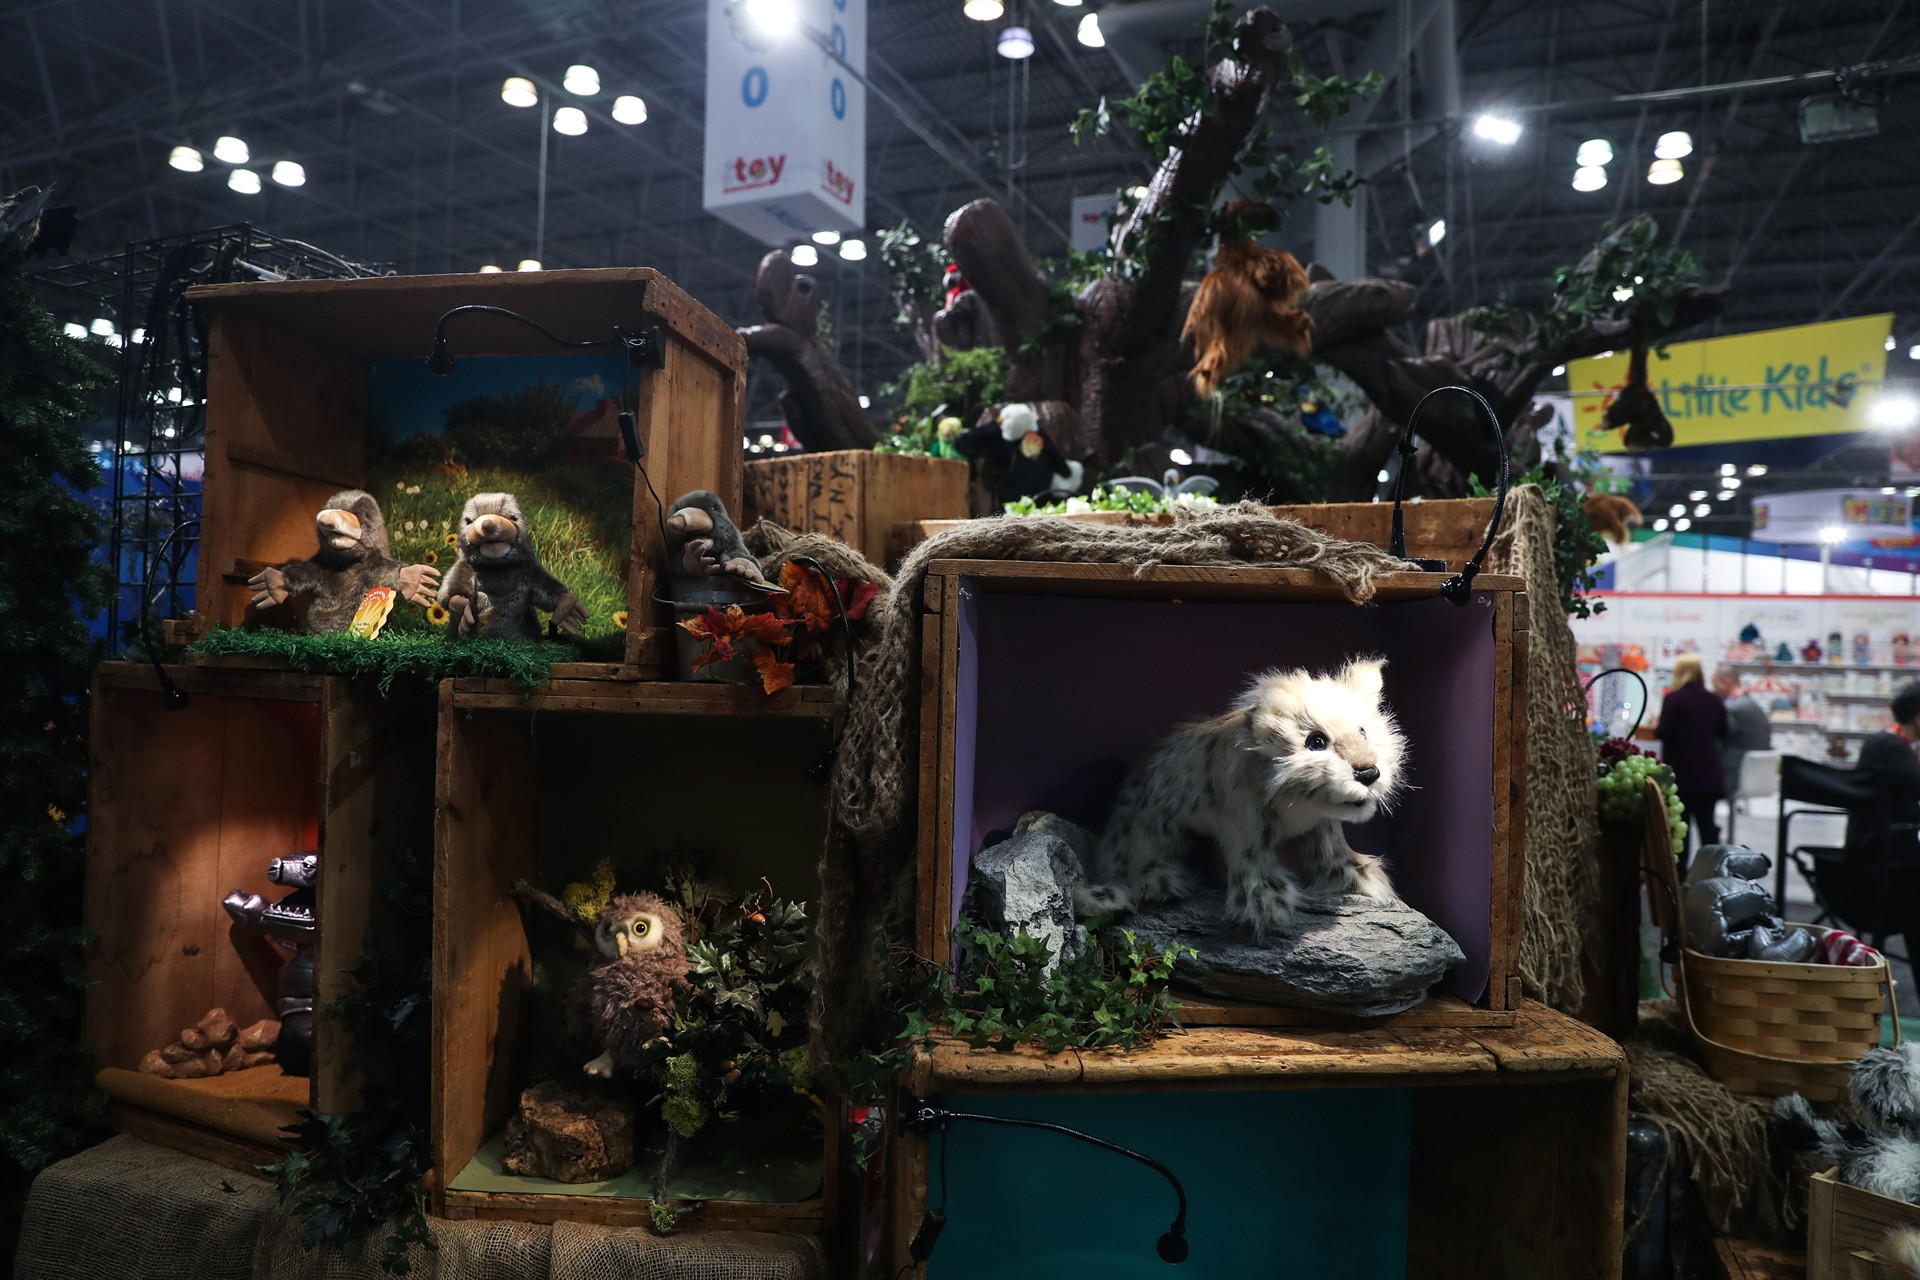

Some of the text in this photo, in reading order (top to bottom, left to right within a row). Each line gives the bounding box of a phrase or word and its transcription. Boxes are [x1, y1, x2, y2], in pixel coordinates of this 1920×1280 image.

[734, 154, 787, 186] toy
[1660, 355, 1859, 418] Little Kids
